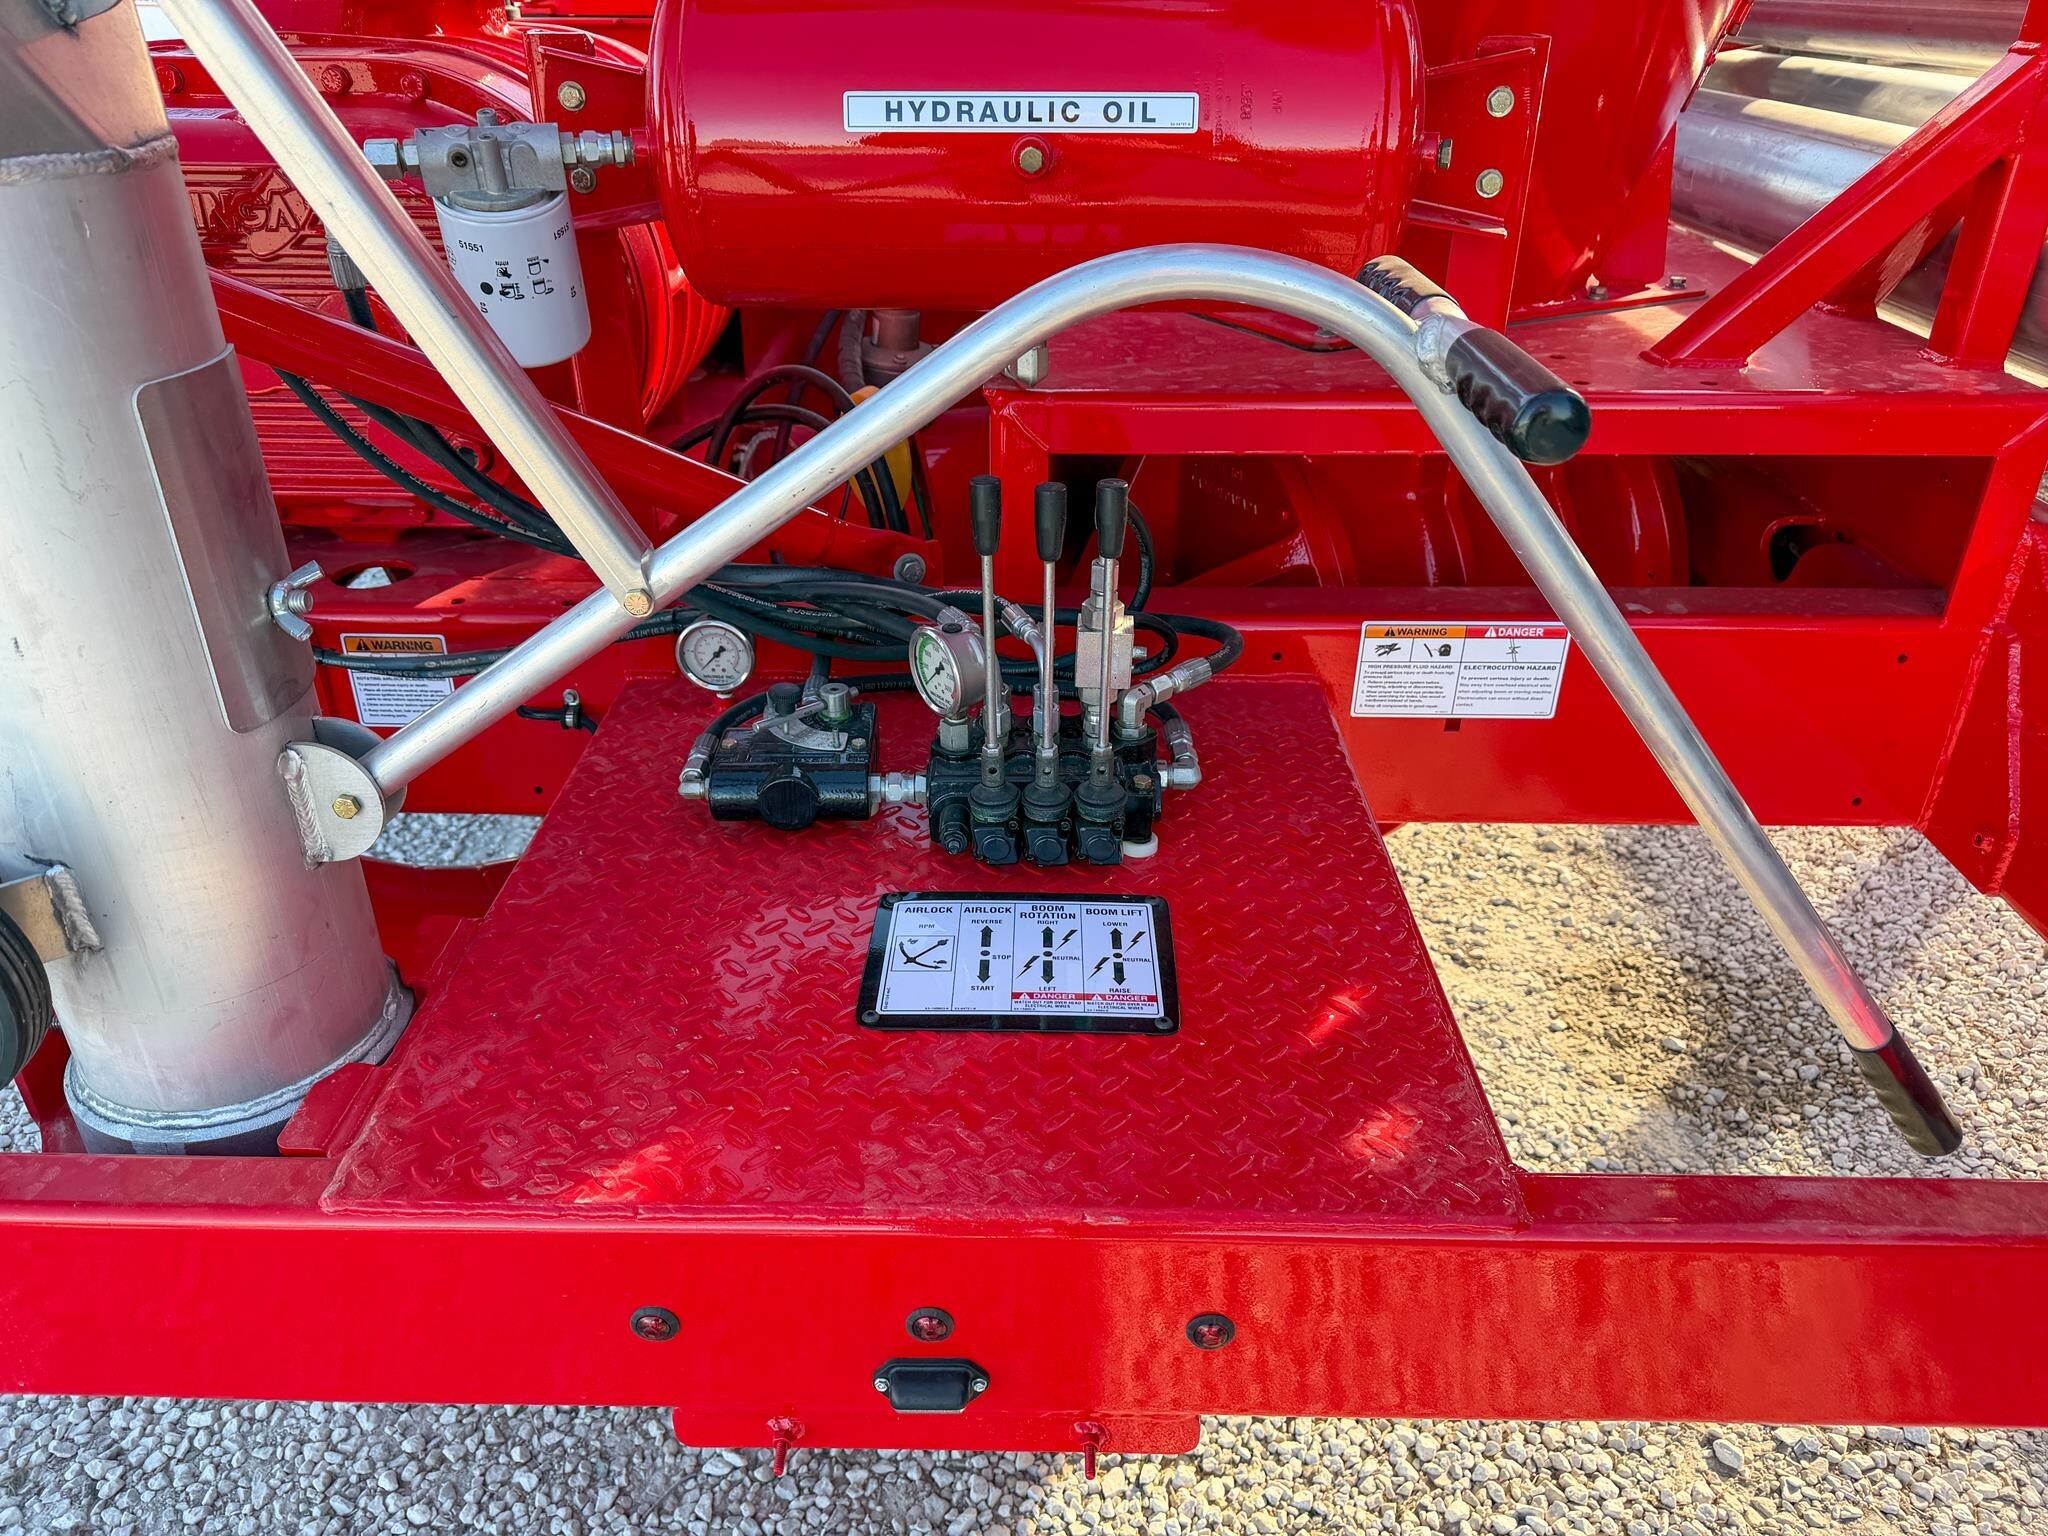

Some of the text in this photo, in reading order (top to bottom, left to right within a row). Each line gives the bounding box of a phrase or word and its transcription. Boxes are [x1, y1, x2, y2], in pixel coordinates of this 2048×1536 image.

[885, 100, 1156, 123] HYDRAULIC OIL
[553, 222, 570, 240] 51551
[459, 240, 484, 253] 51551
[1397, 628, 1448, 636] WARNING
[1498, 628, 1544, 637] DANGER
[372, 641, 433, 650] WARNING
